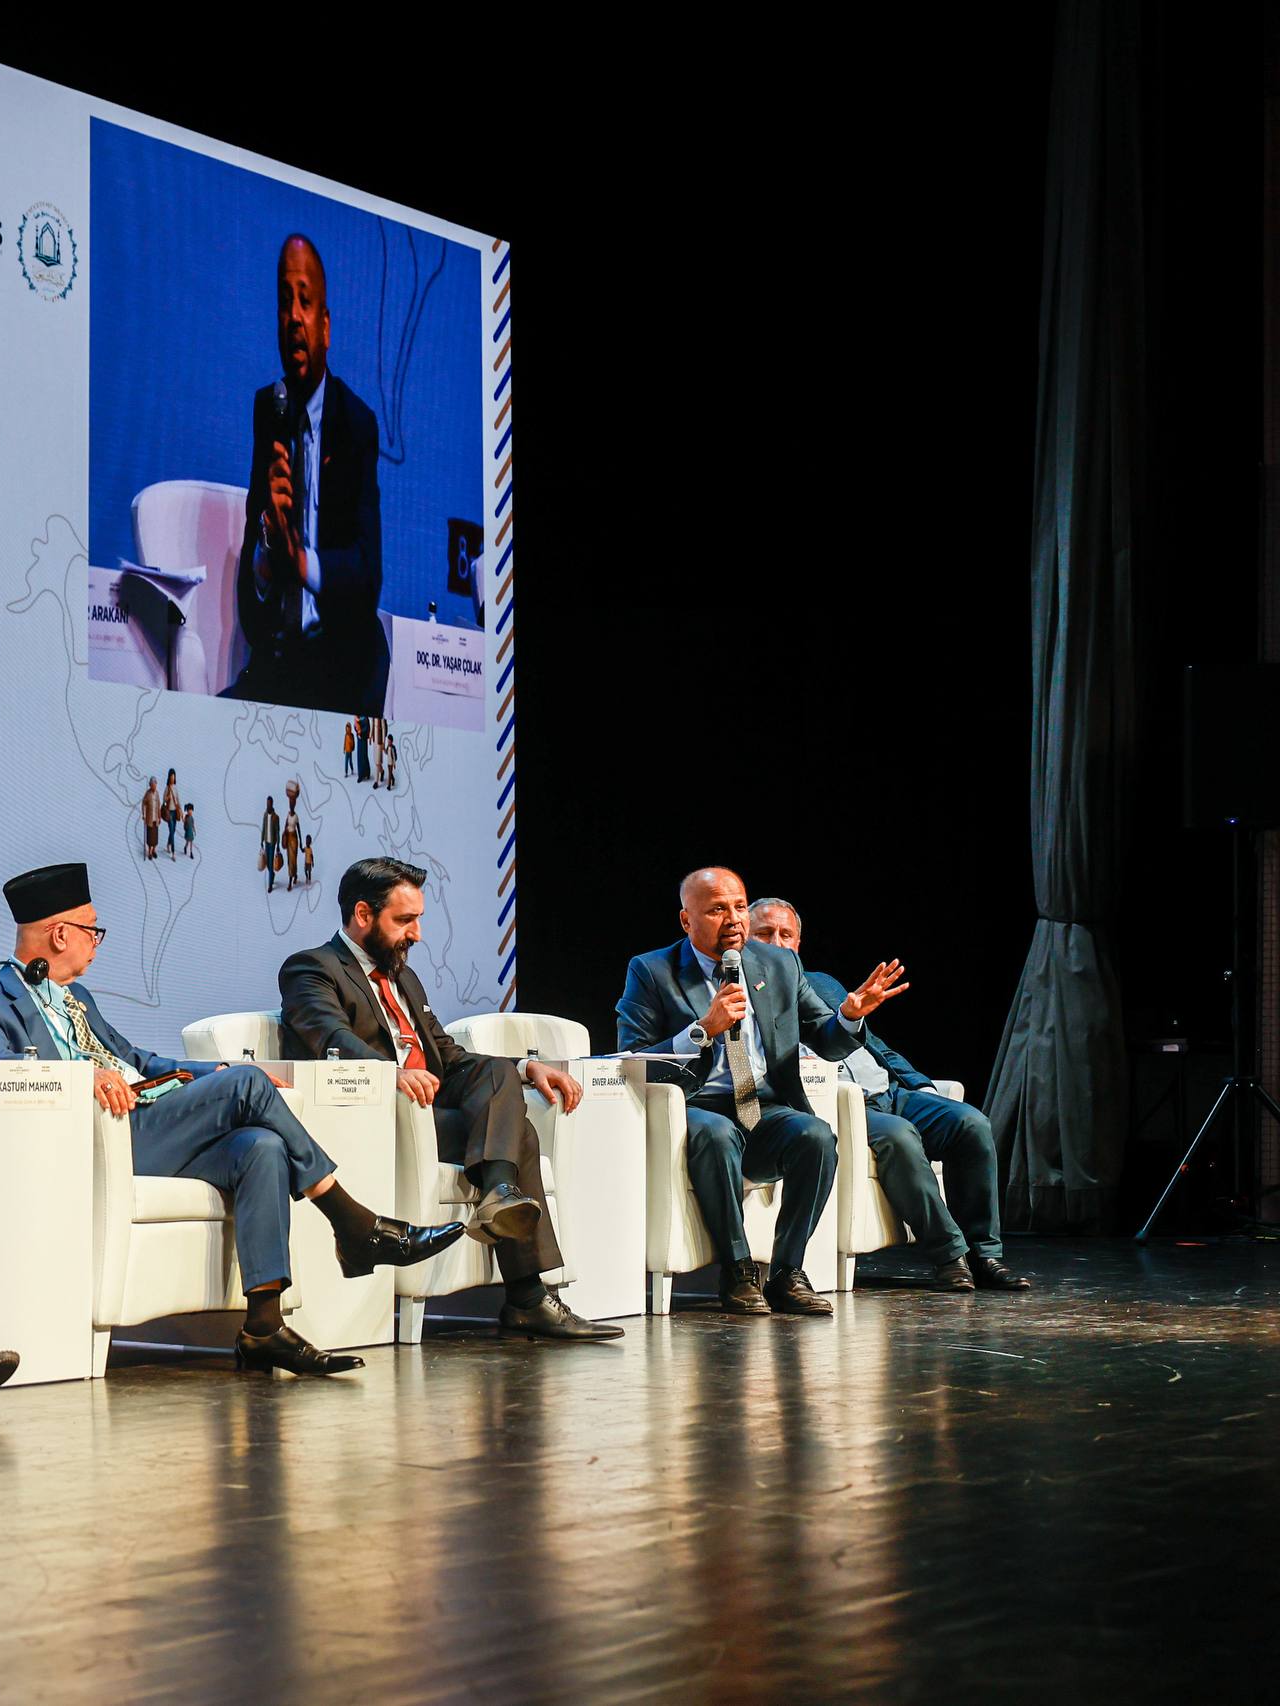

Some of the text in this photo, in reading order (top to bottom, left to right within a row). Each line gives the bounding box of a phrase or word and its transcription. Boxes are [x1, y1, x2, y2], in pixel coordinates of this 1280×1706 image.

[431, 653, 442, 668] DR.
[442, 655, 462, 674] YAŞAR
[462, 659, 482, 676] ÇOLAK
[28, 1081, 62, 1092] MAHKOTA
